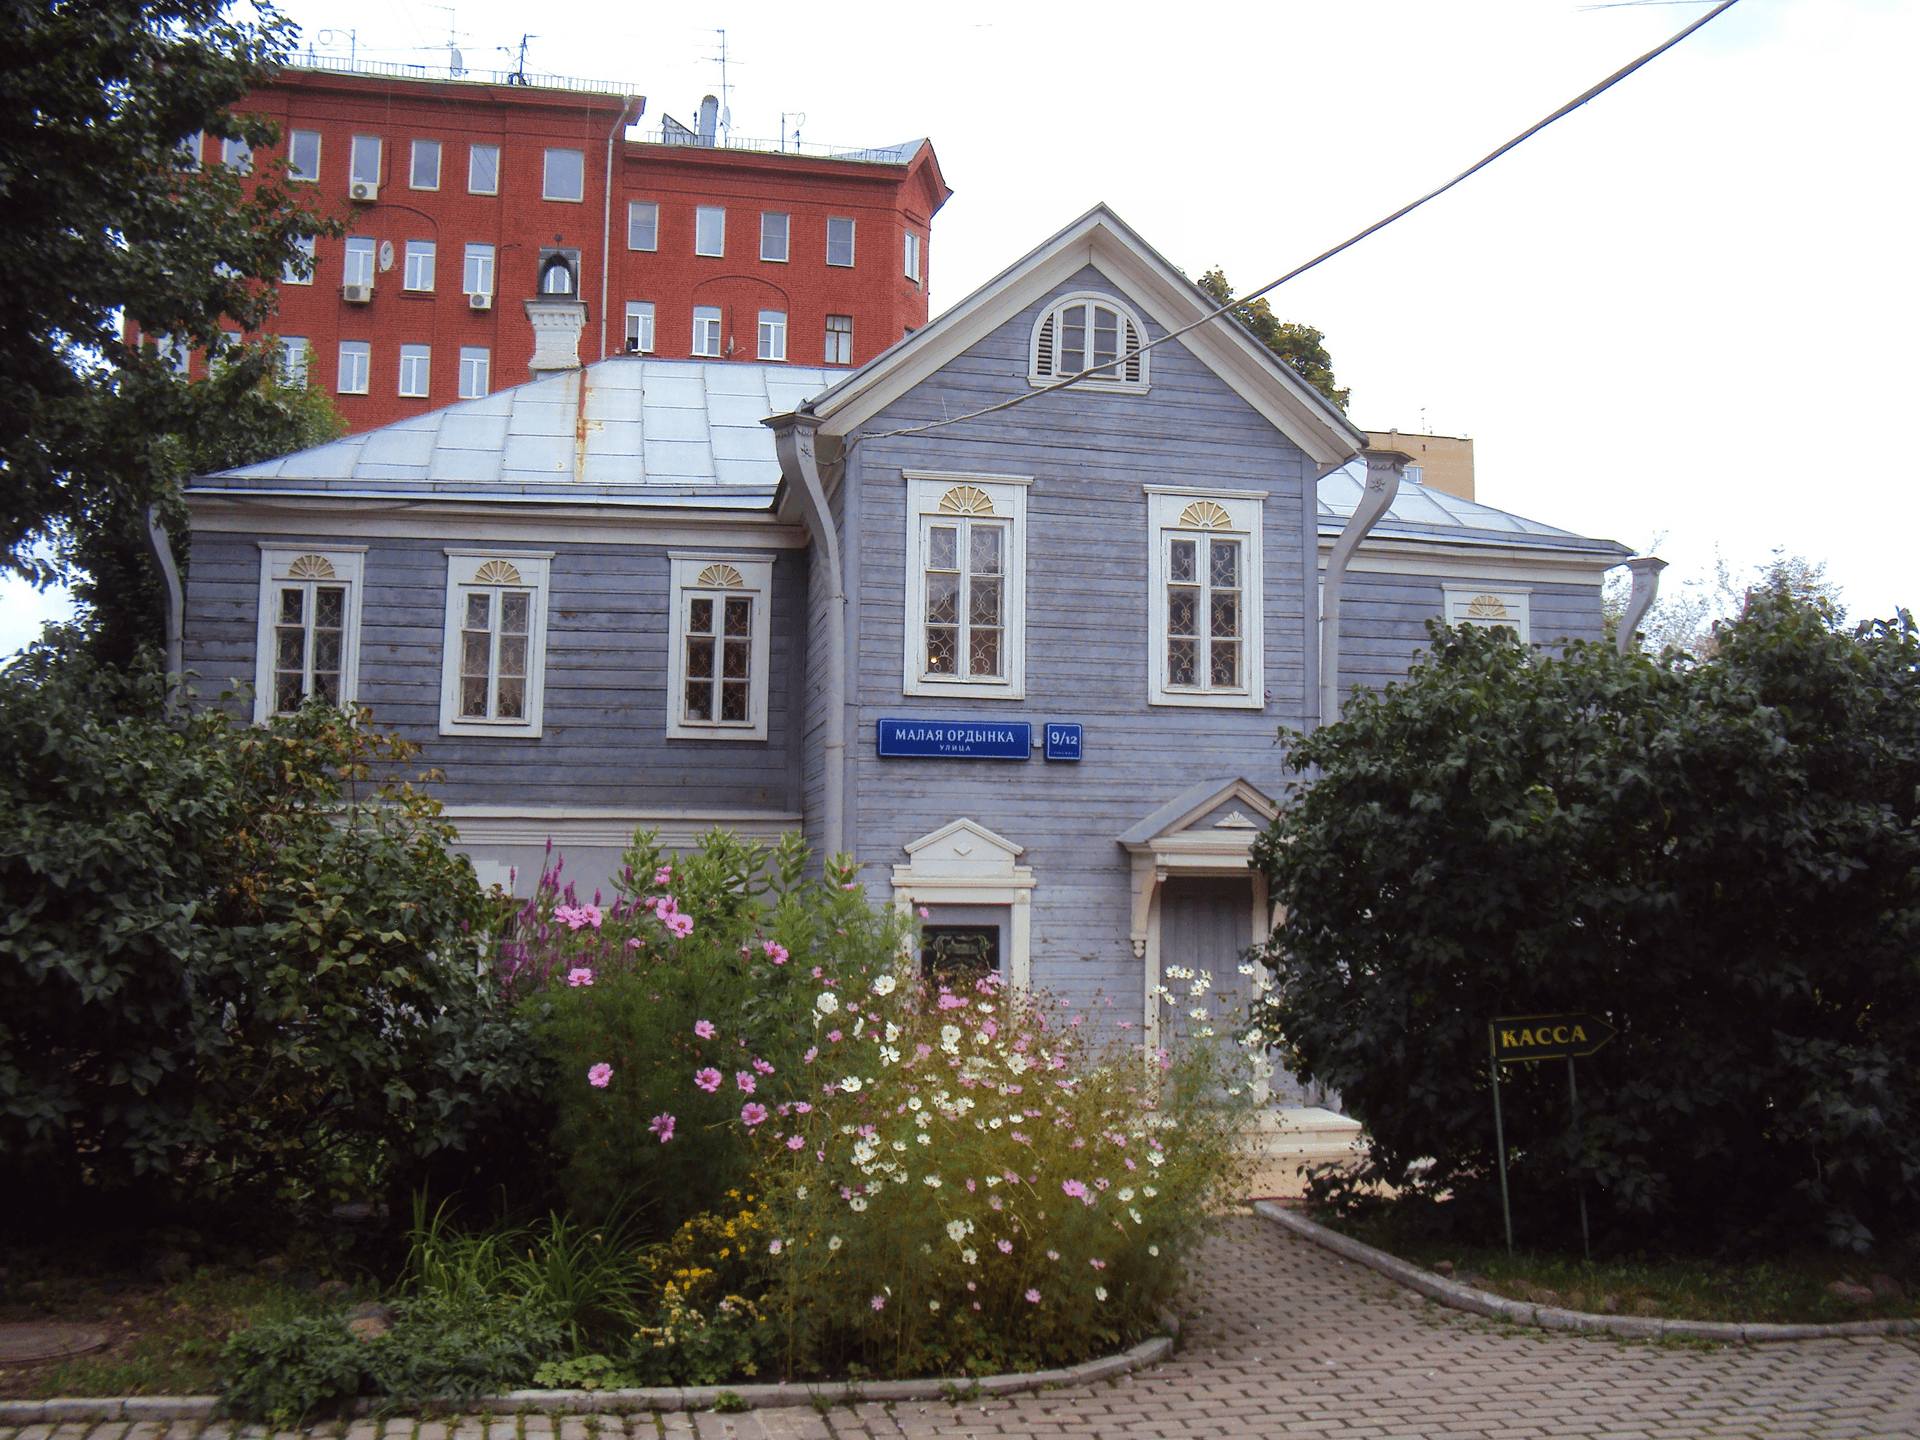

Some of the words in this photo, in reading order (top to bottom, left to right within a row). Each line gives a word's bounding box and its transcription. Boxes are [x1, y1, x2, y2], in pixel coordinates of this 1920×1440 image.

[895, 728, 943, 742] МАЛАЯ
[947, 729, 1015, 743] ОРДЫНКА
[1051, 731, 1078, 746] 9/12
[939, 744, 971, 752] УЛИЦА
[1501, 1025, 1588, 1048] КАССА
